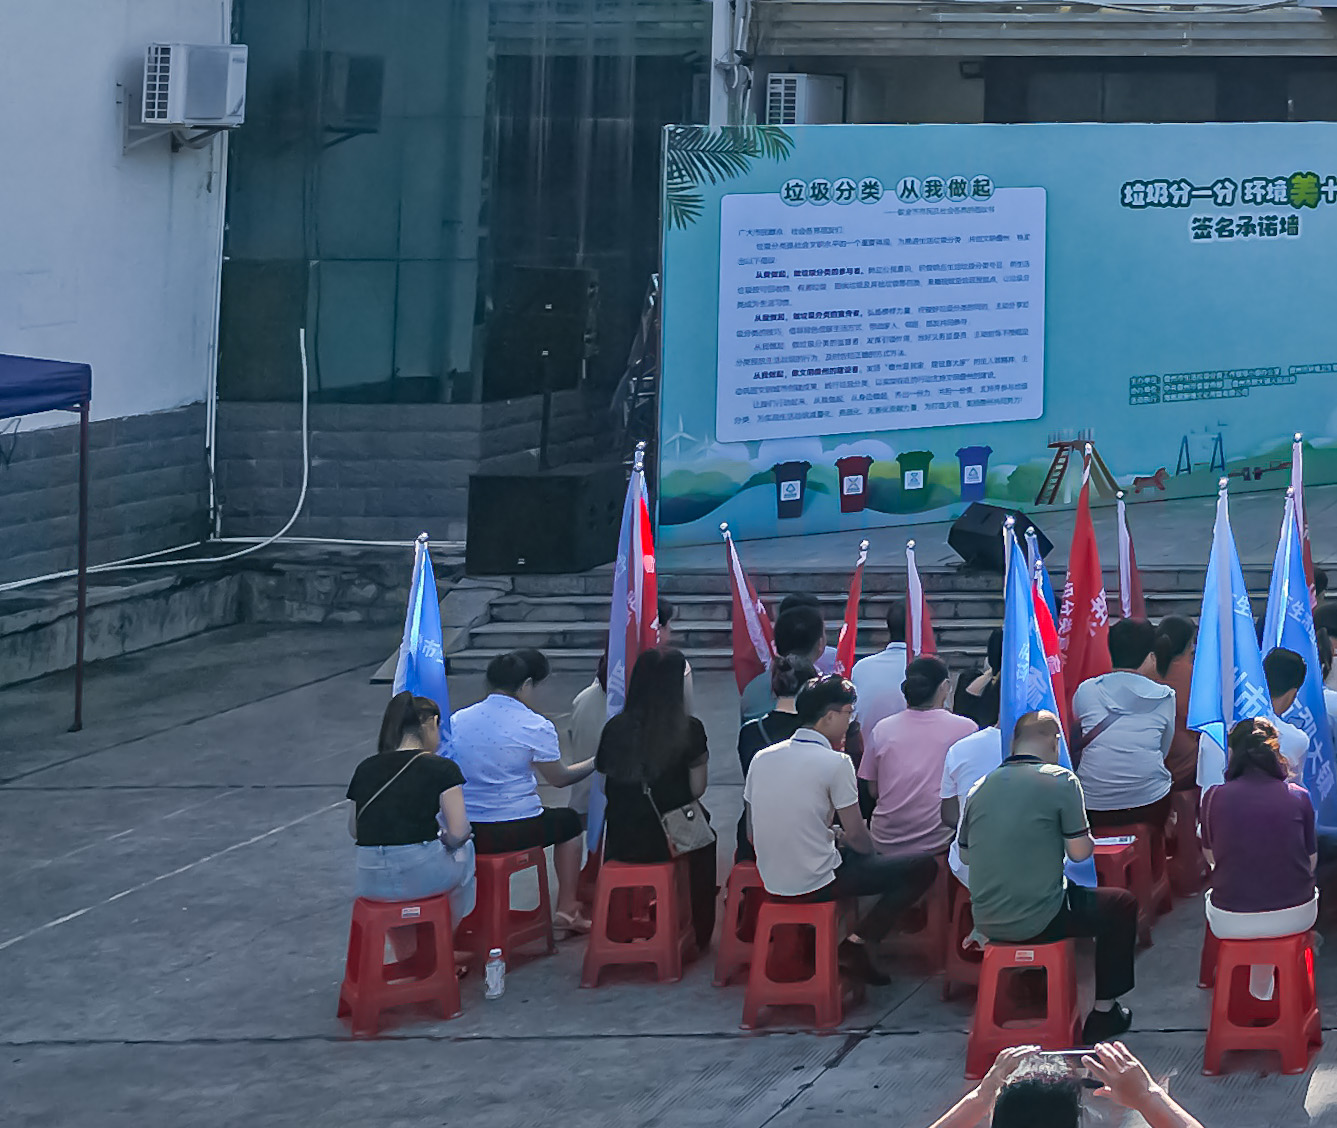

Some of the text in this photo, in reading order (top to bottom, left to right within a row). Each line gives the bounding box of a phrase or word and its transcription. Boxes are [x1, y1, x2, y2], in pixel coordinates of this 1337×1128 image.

[784, 178, 992, 202] 垃圾分类 从我做起
[1121, 178, 1238, 207] 垃圾分一分
[1191, 214, 1300, 240] 签名承诺墙
